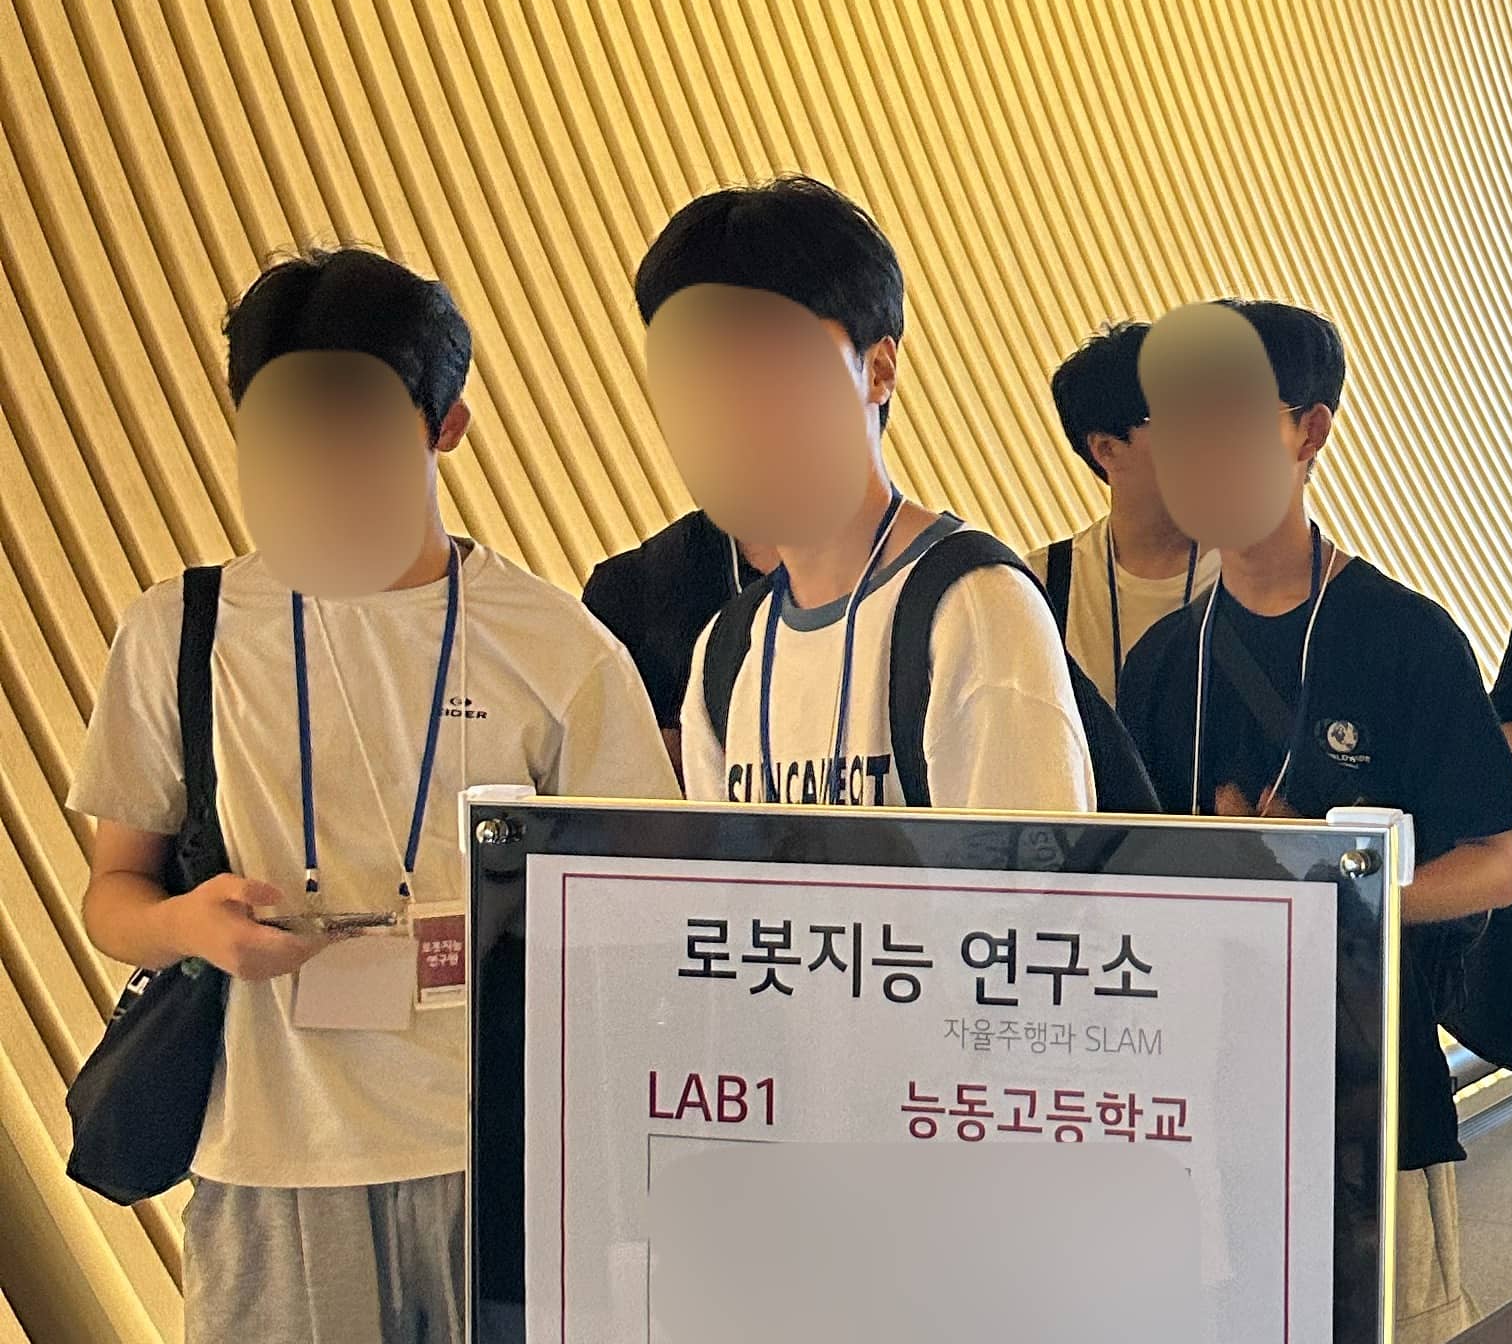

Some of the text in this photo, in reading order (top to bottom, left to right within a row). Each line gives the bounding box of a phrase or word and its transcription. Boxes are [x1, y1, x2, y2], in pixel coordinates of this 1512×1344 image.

[440, 707, 488, 719] IDER
[677, 918, 1159, 1007] 로봇지능 연구소
[943, 1017, 1163, 1055] 자율주행과 SLAM
[649, 1070, 775, 1126] LAB1
[900, 1080, 1193, 1143] 능동고등학교
